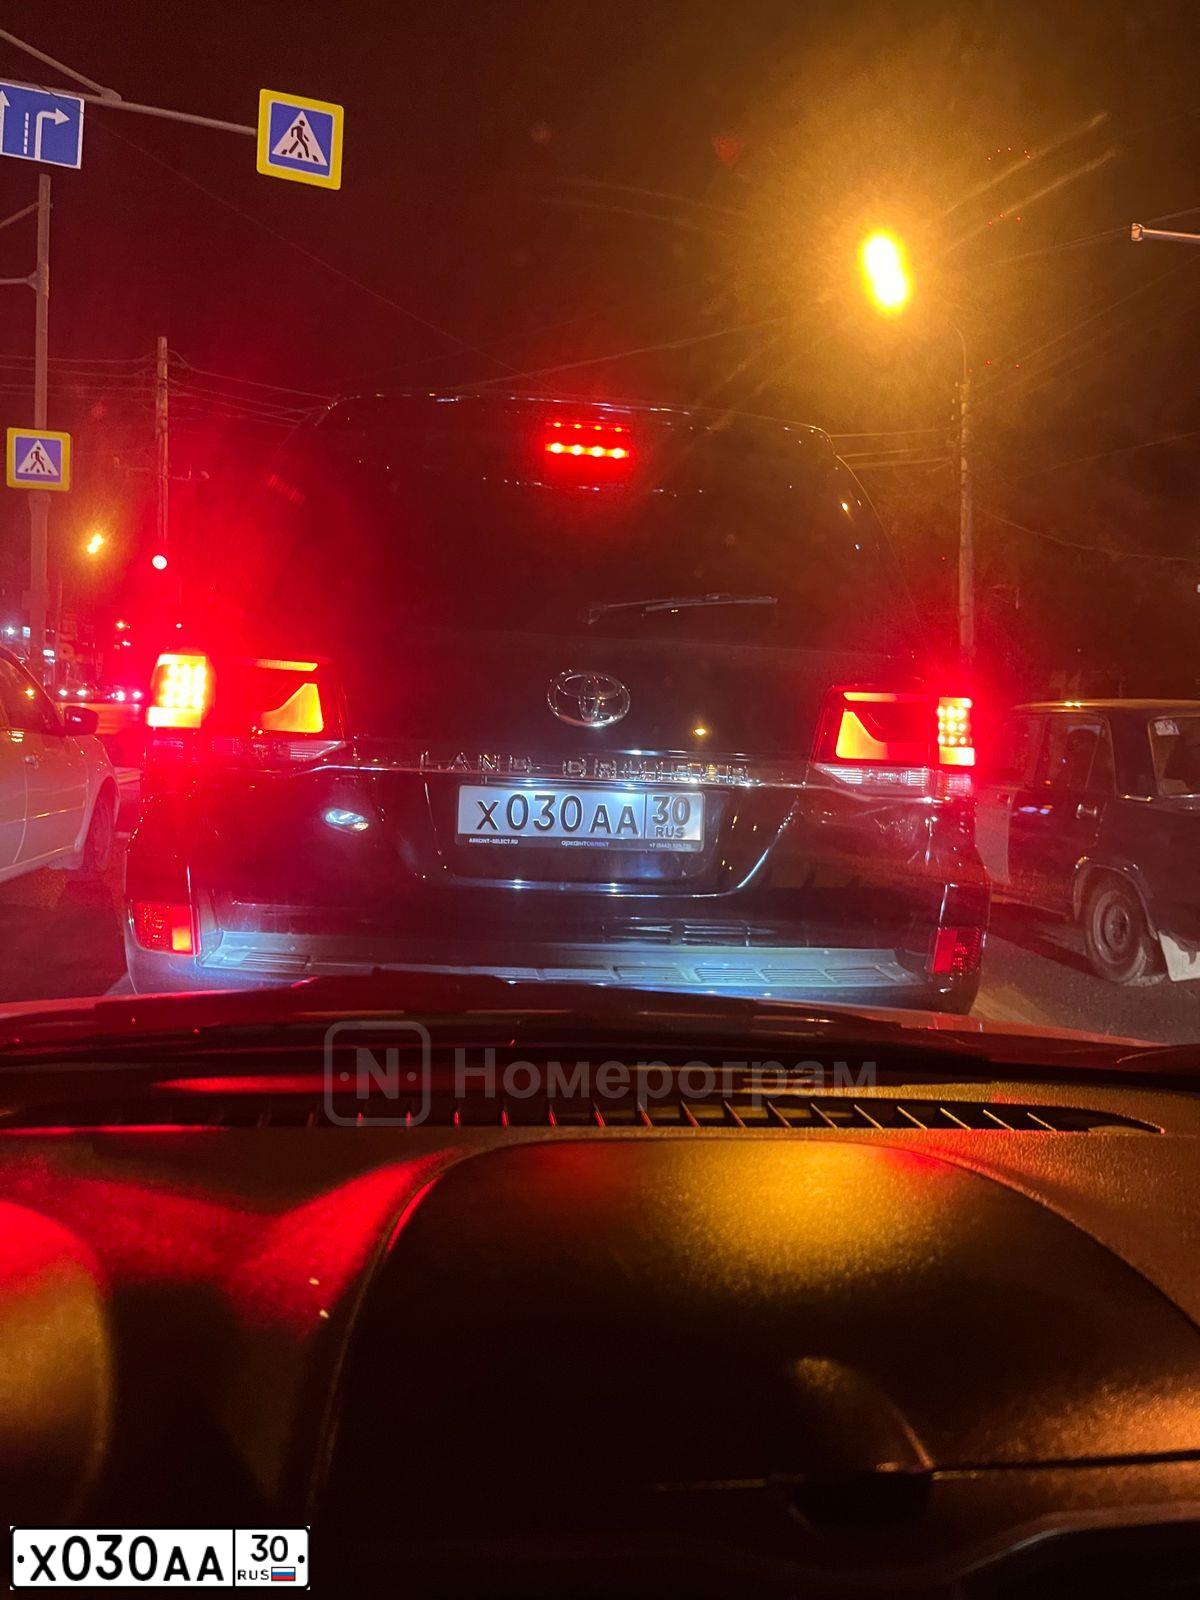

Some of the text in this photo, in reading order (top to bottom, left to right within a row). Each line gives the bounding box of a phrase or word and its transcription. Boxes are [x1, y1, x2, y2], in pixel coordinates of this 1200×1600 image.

[419, 751, 533, 774] LAND
[652, 796, 691, 826] 30
[655, 825, 685, 838] RUS
